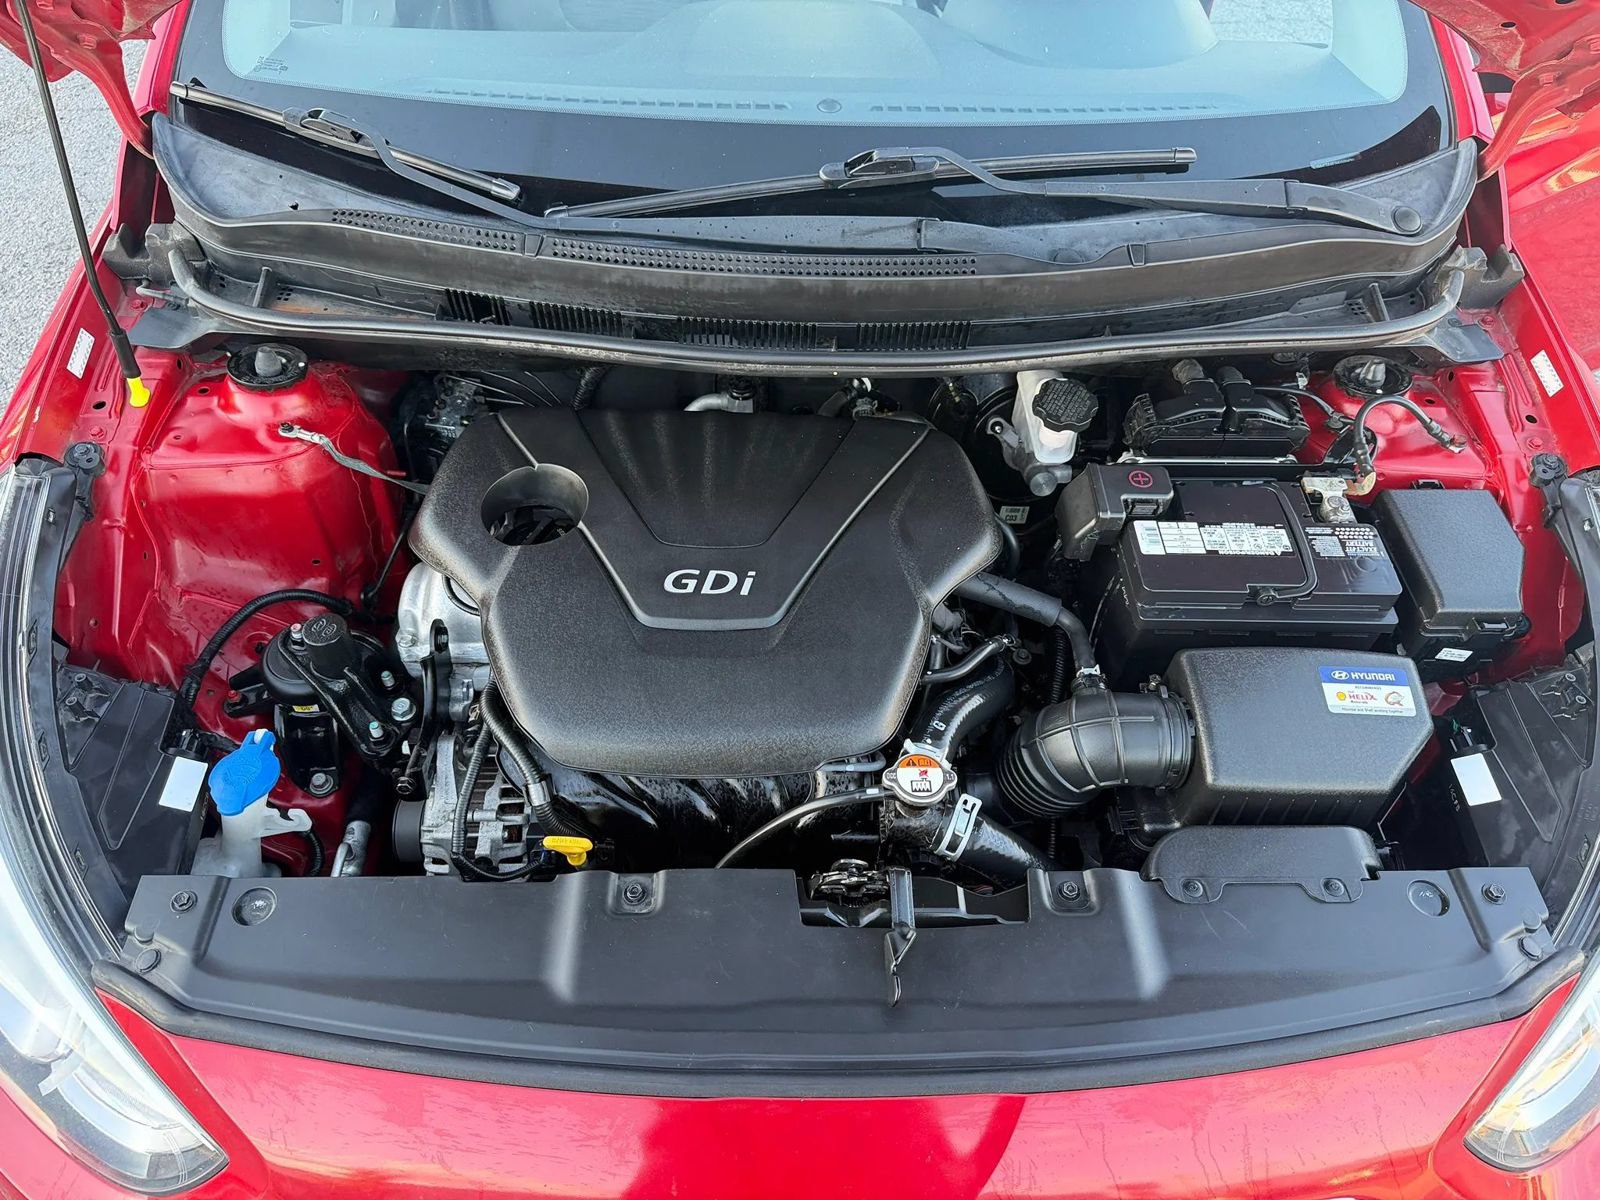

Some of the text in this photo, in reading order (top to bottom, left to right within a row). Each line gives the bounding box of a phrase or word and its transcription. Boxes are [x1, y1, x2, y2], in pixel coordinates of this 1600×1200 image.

[663, 569, 756, 596] GDi
[1351, 672, 1396, 681] HYUNDAI
[1348, 693, 1378, 701] HELIX
